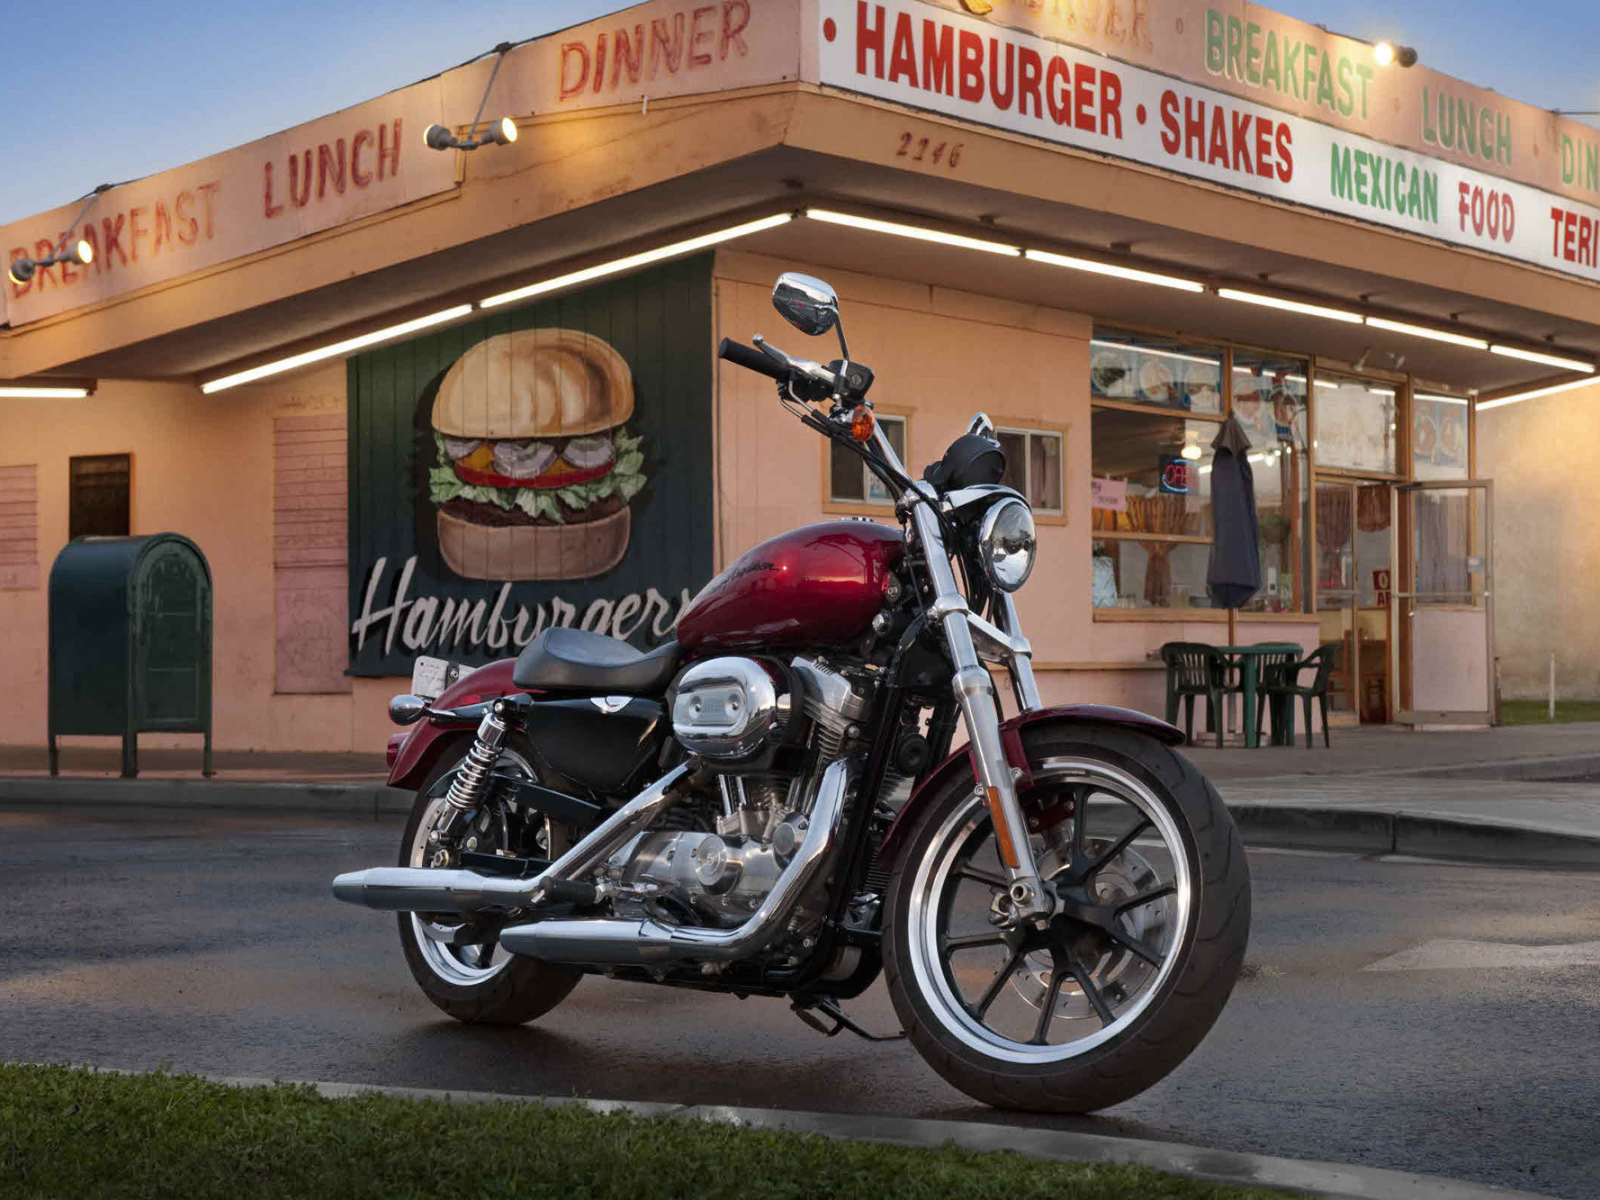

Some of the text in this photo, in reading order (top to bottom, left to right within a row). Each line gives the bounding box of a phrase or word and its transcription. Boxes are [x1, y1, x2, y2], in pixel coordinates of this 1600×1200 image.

[9, 0, 751, 299] BREAKFAST LUNCH DINNER
[856, 0, 1123, 140] HAMBURGER
[1160, 90, 1293, 184] SHAKES
[1330, 142, 1439, 224] MEXICAN
[1458, 182, 1515, 243] FOOD
[1551, 207, 1600, 268] TERI
[1205, 8, 1374, 120] BREAKFAST
[1421, 86, 1512, 167] LUNCH
[1561, 133, 1600, 193] DIN
